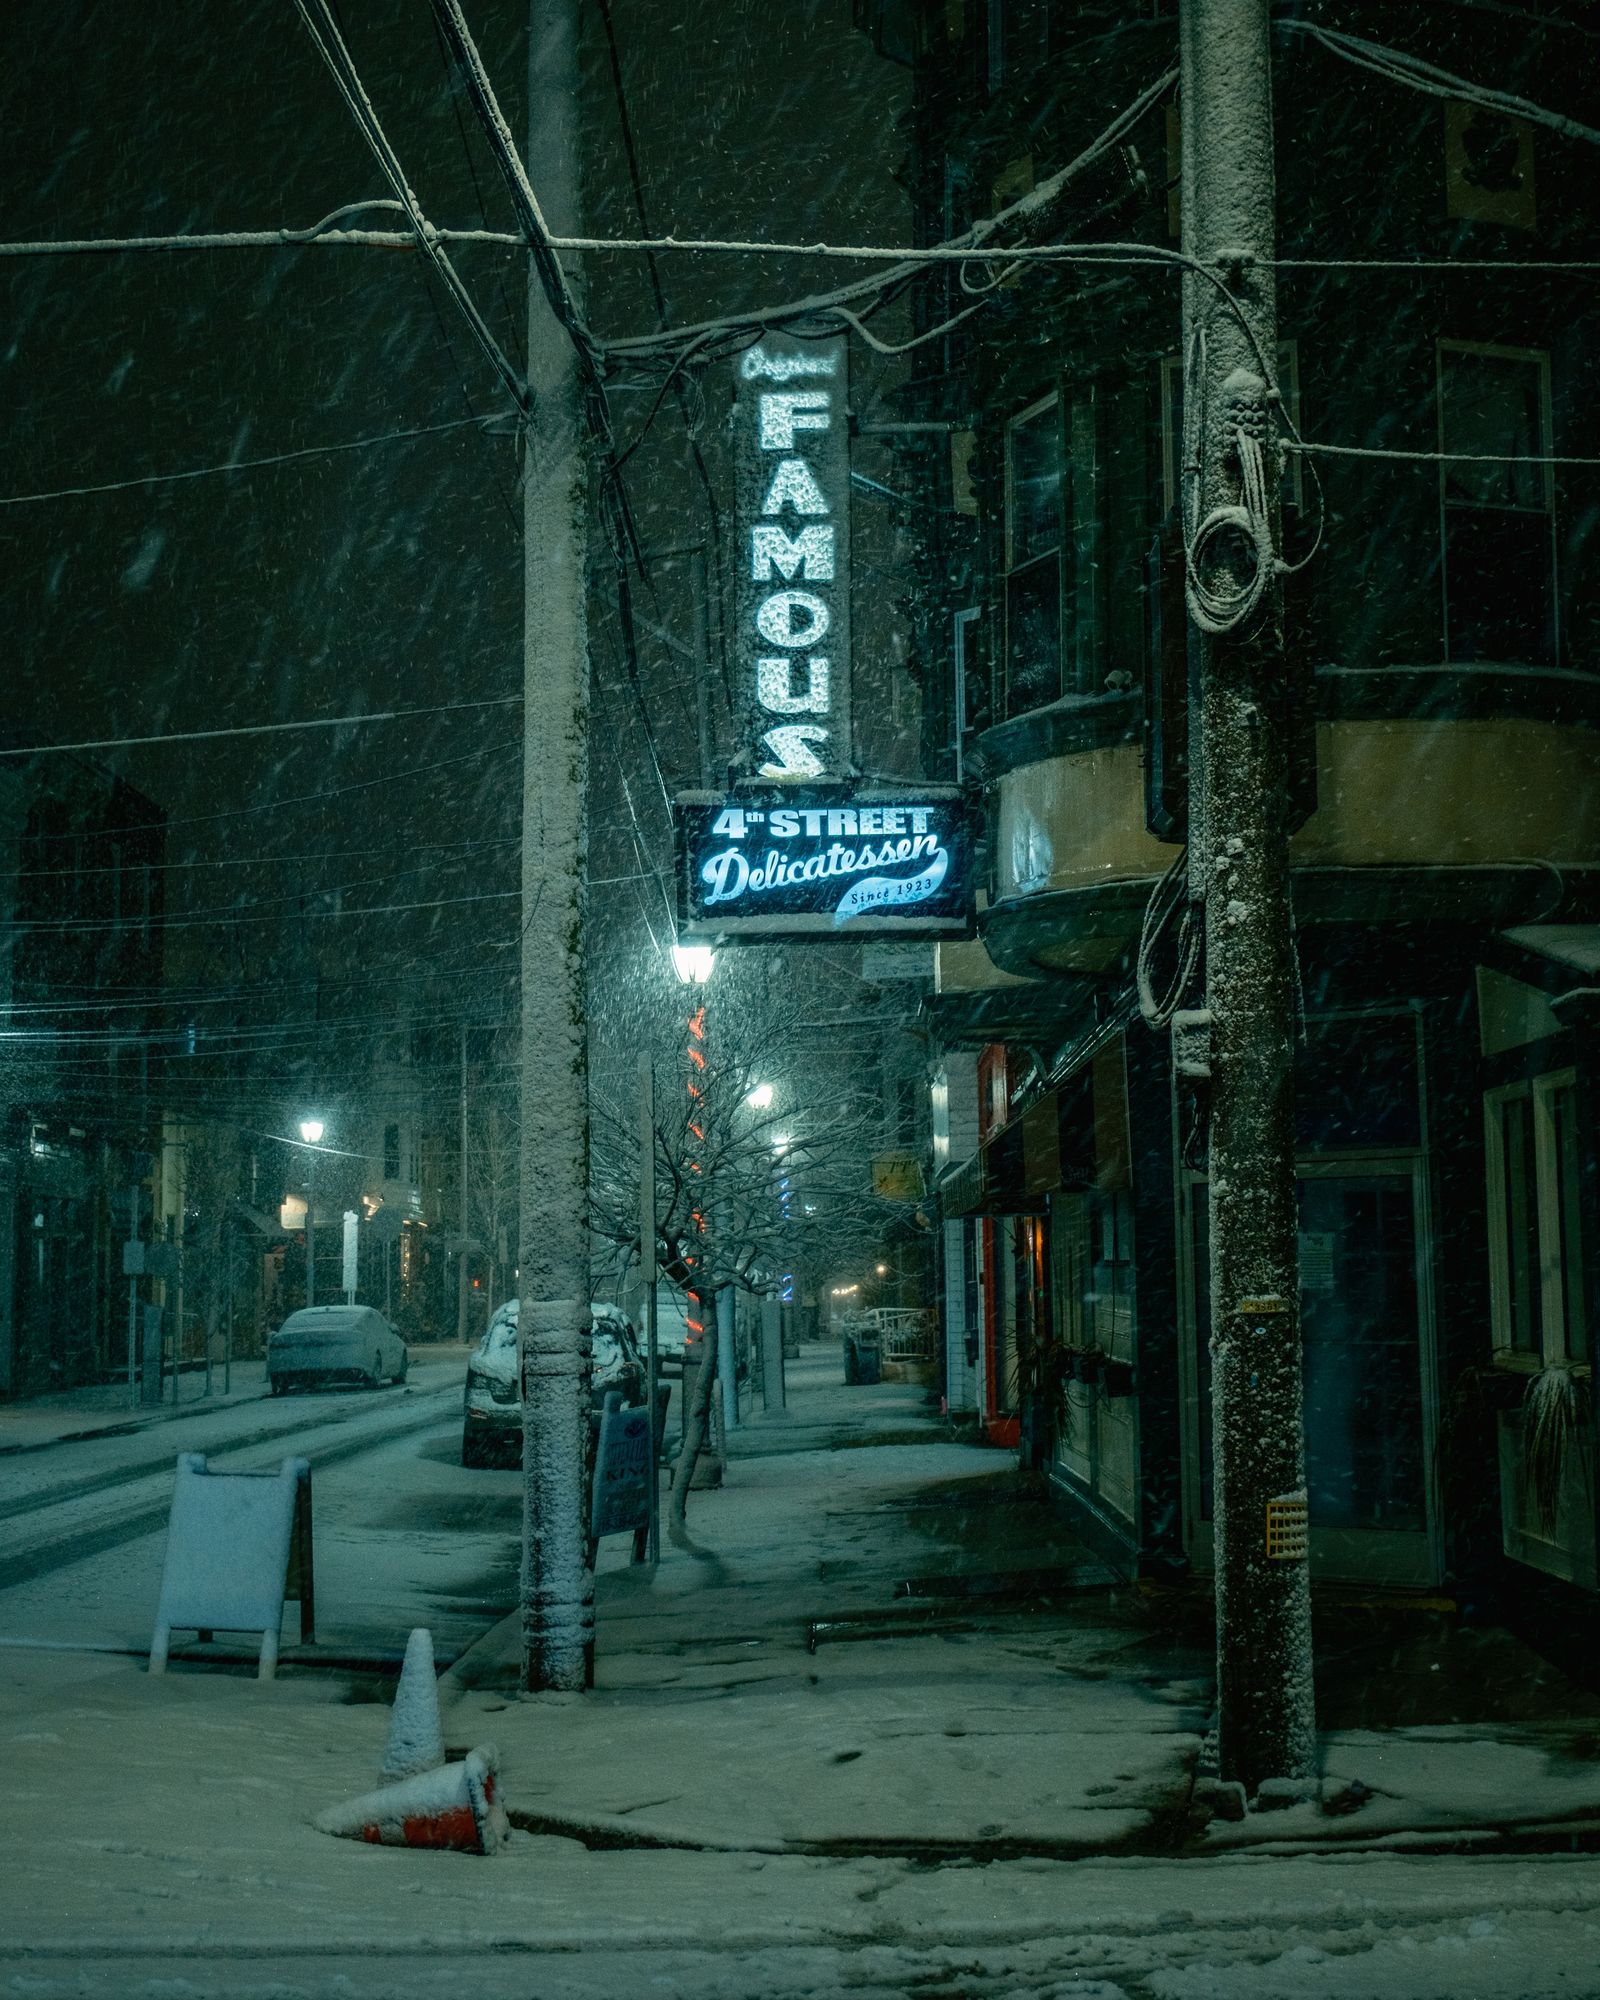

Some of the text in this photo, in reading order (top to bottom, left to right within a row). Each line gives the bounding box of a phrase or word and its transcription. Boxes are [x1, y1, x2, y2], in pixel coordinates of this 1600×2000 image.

[753, 392, 835, 777] FAMOUS
[713, 807, 934, 838] 4th STREET
[702, 834, 940, 905] Delicatessen
[851, 878, 932, 904] Since 1923
